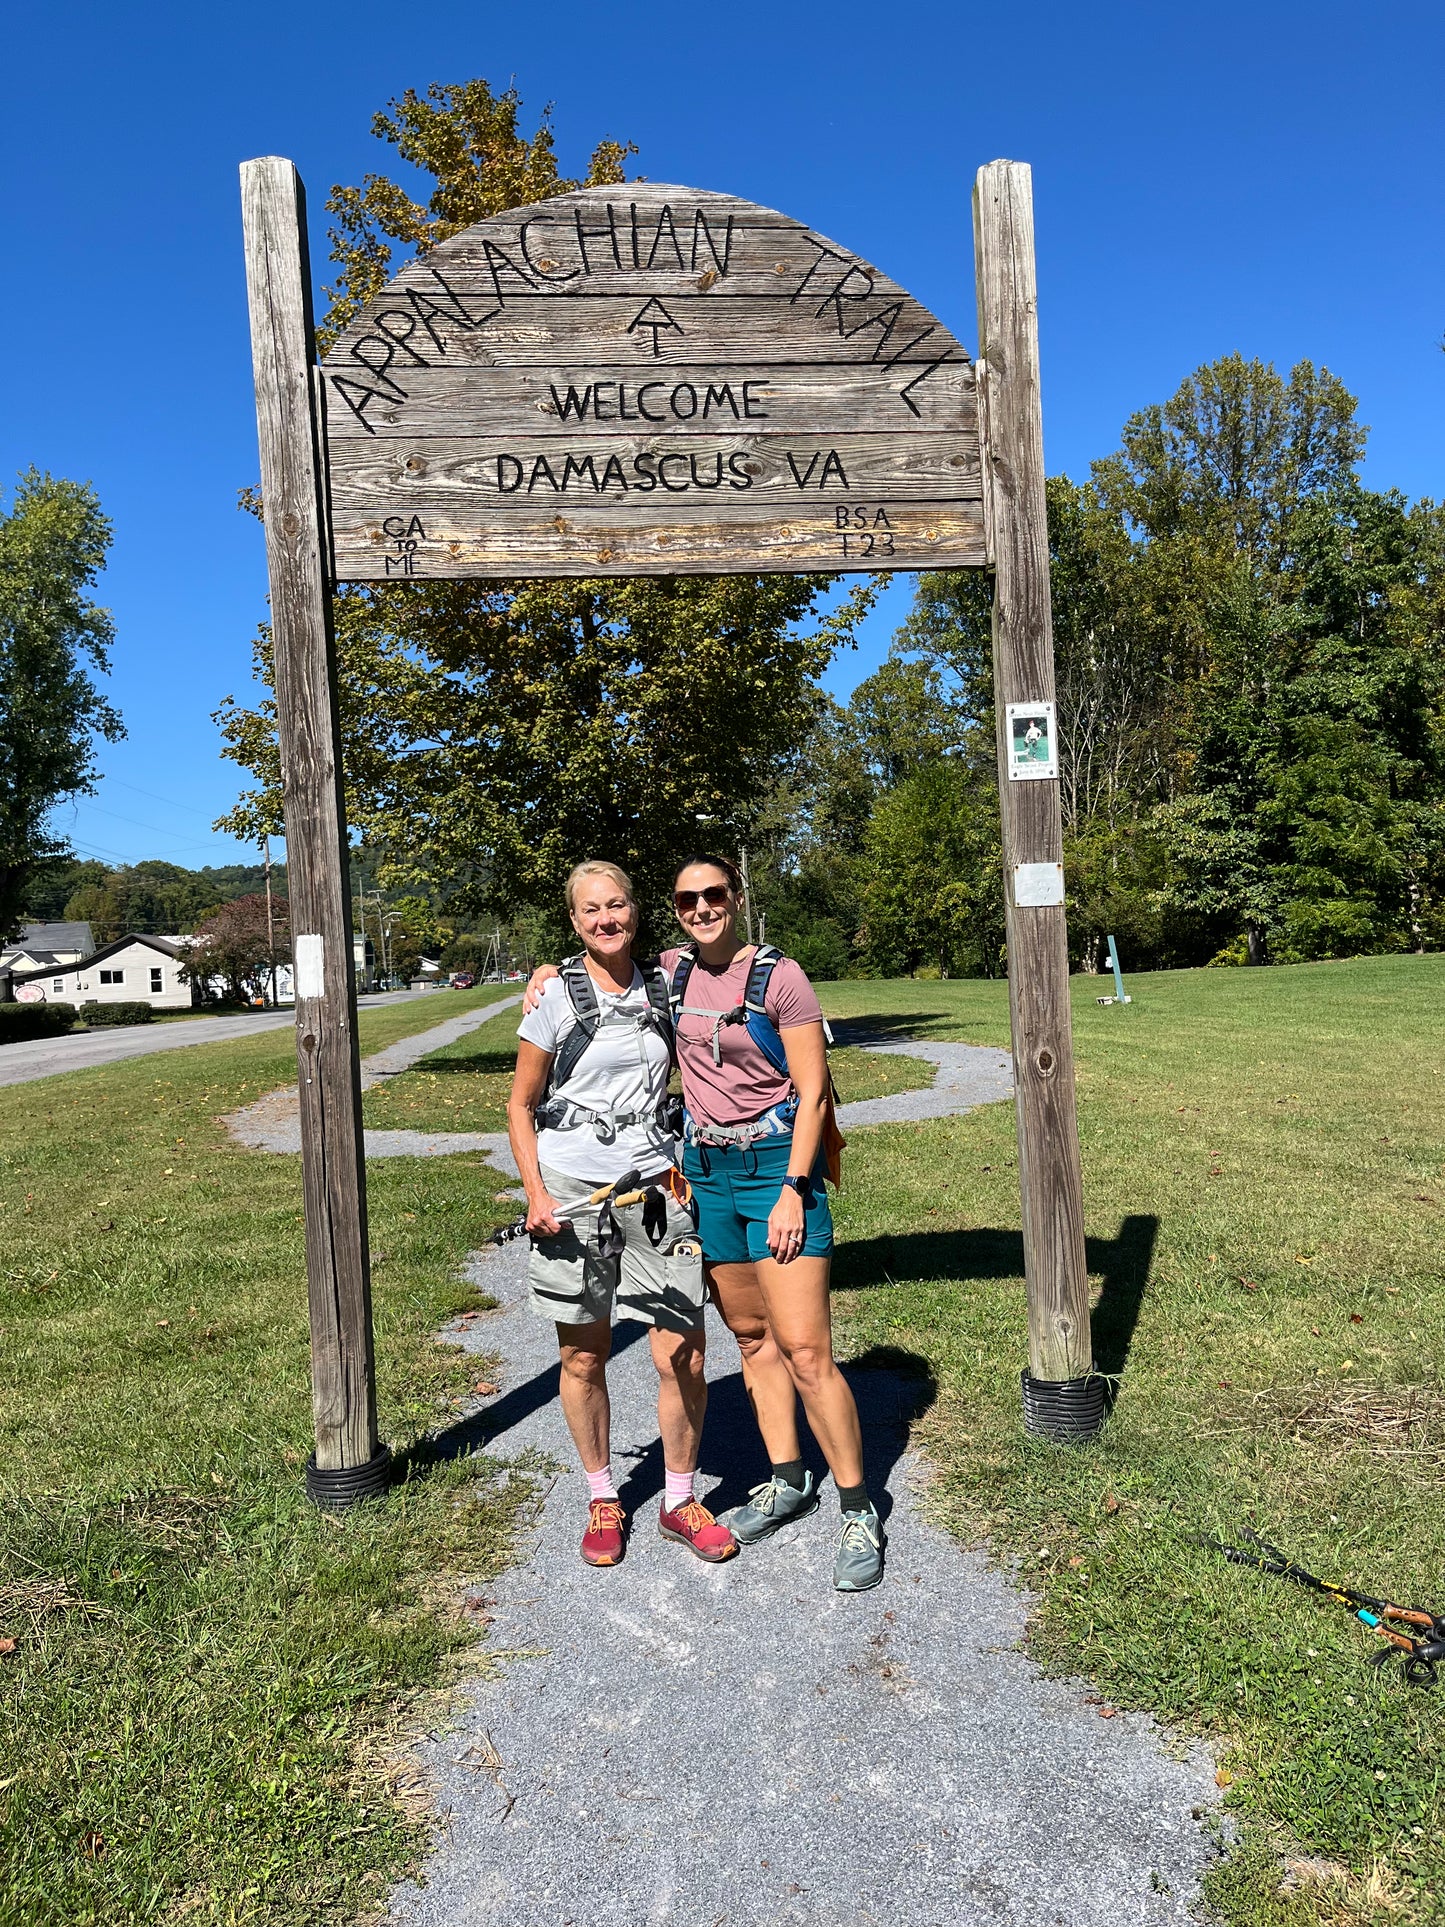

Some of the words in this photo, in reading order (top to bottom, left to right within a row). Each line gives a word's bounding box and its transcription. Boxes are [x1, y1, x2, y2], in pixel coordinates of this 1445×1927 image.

[330, 202, 734, 436] APPALACHIAN
[789, 235, 954, 419] TRAIL
[550, 379, 770, 422] WELCOME
[496, 451, 754, 493] DAMASCUS
[786, 449, 851, 491] VA
[383, 514, 426, 540] GA
[835, 505, 891, 530] BSA
[385, 552, 429, 576] ME
